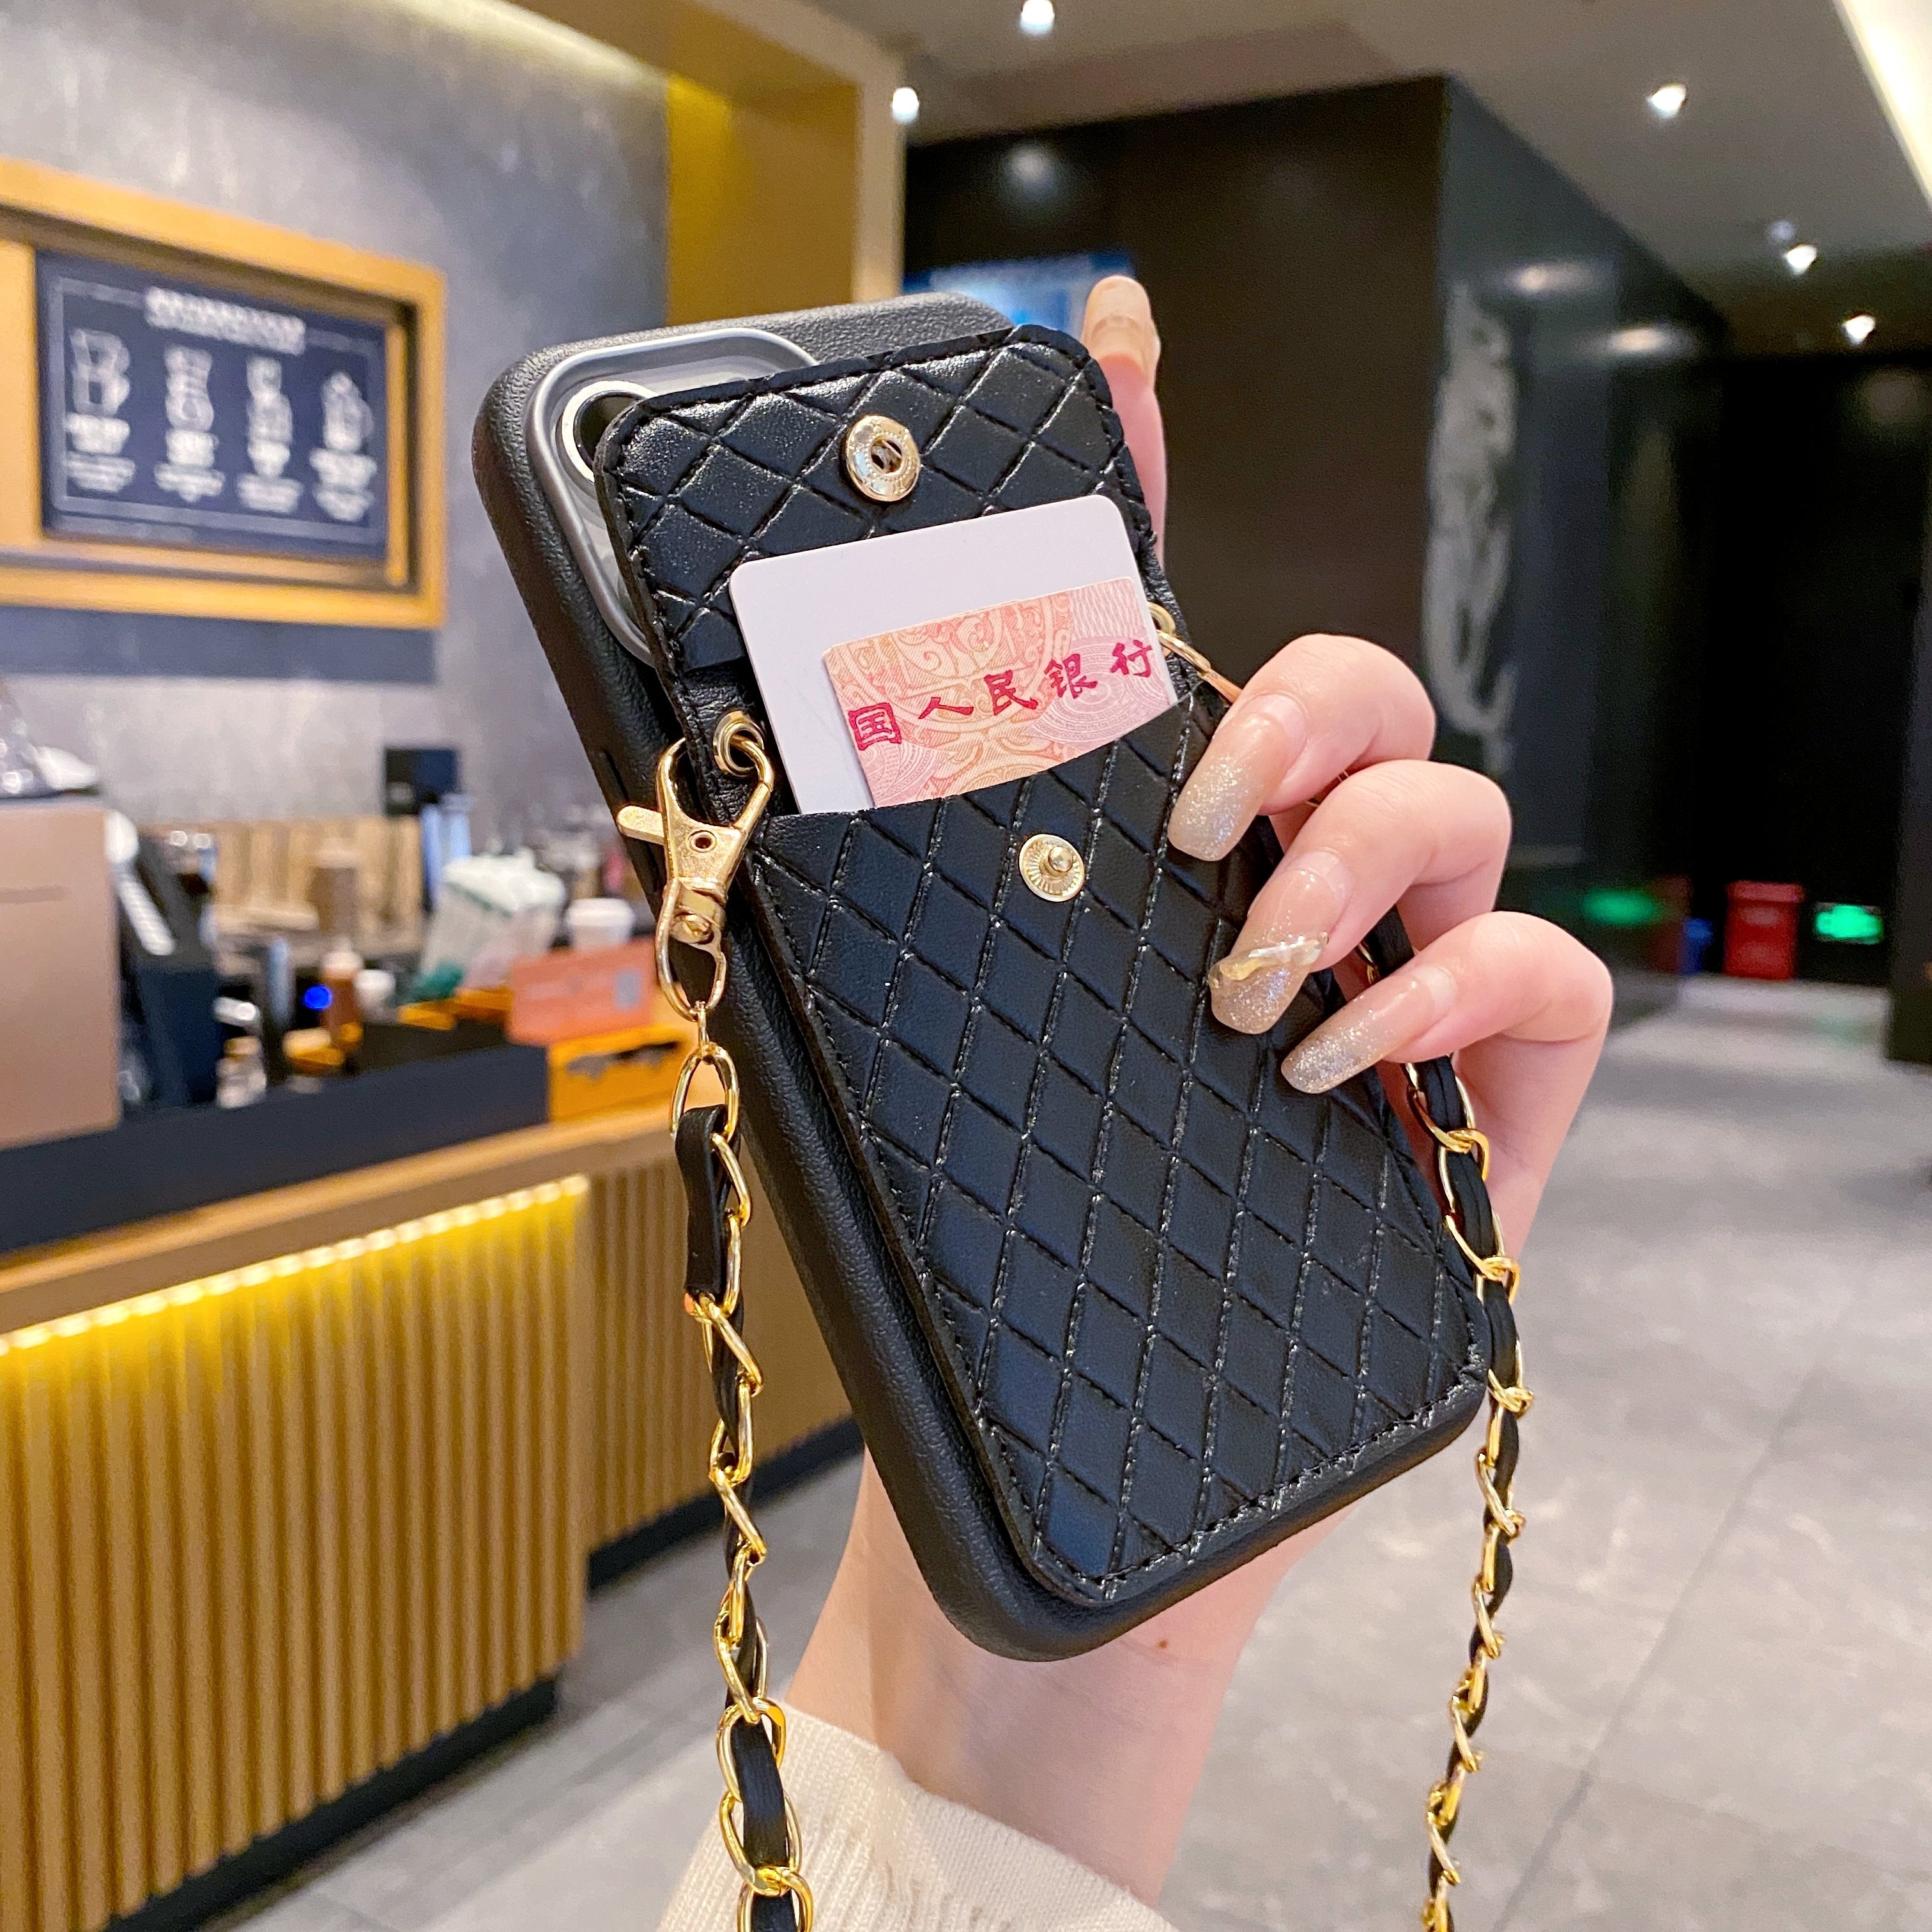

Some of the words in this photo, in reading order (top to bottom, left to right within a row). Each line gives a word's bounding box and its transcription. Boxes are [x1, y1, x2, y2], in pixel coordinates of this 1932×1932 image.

[848, 639, 1153, 751] 国人民银行
